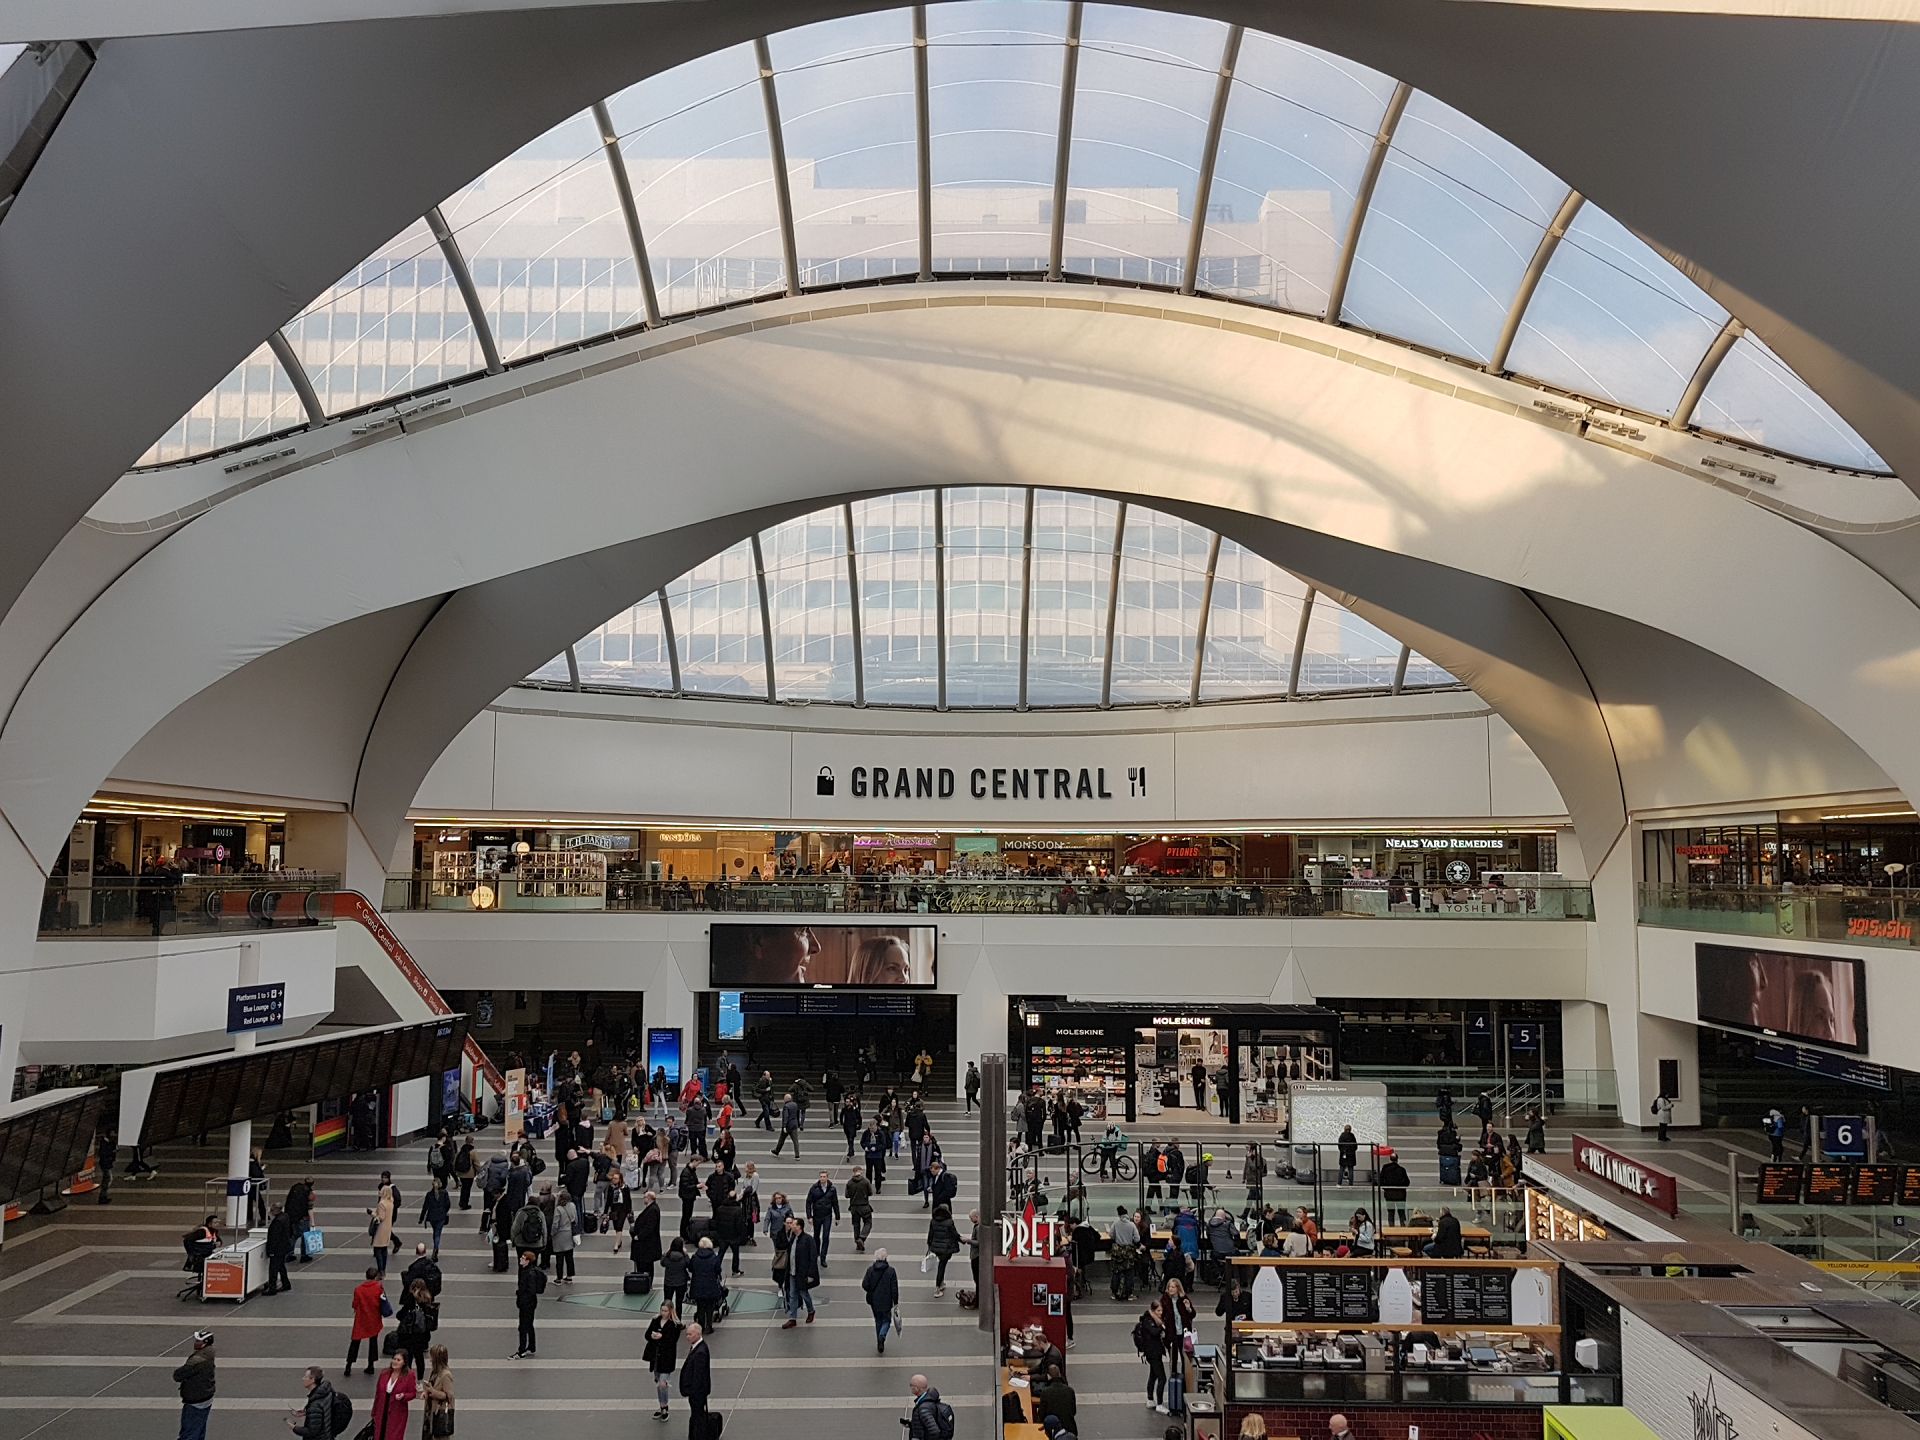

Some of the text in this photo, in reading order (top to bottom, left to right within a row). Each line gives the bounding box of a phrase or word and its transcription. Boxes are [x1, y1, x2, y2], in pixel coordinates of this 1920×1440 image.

[851, 766, 1112, 799] GRAND CENTRAL
[659, 832, 702, 842] PANDORA
[1004, 840, 1063, 850] MONSOON
[1385, 838, 1503, 849] NEAL'S YARD REMEDIES
[1167, 847, 1199, 857] PYLONES
[1446, 904, 1487, 913] YOSHE
[362, 909, 378, 932] Grand
[377, 928, 395, 953] Central
[236, 994, 257, 1002] Platforms
[243, 1004, 269, 1013] Blue Lounge
[243, 1016, 269, 1025] Red Lounge
[1153, 1017, 1211, 1025] MOLESKINE
[1475, 1017, 1484, 1029] 4
[1520, 1029, 1530, 1043] 5
[1837, 1125, 1853, 1146] 6
[1588, 1147, 1605, 1177] PRET
[1606, 1156, 1612, 1181] A
[1612, 1159, 1642, 1195] MANGER
[1896, 1217, 1903, 1225] 6
[1001, 1215, 1060, 1257] PRET
